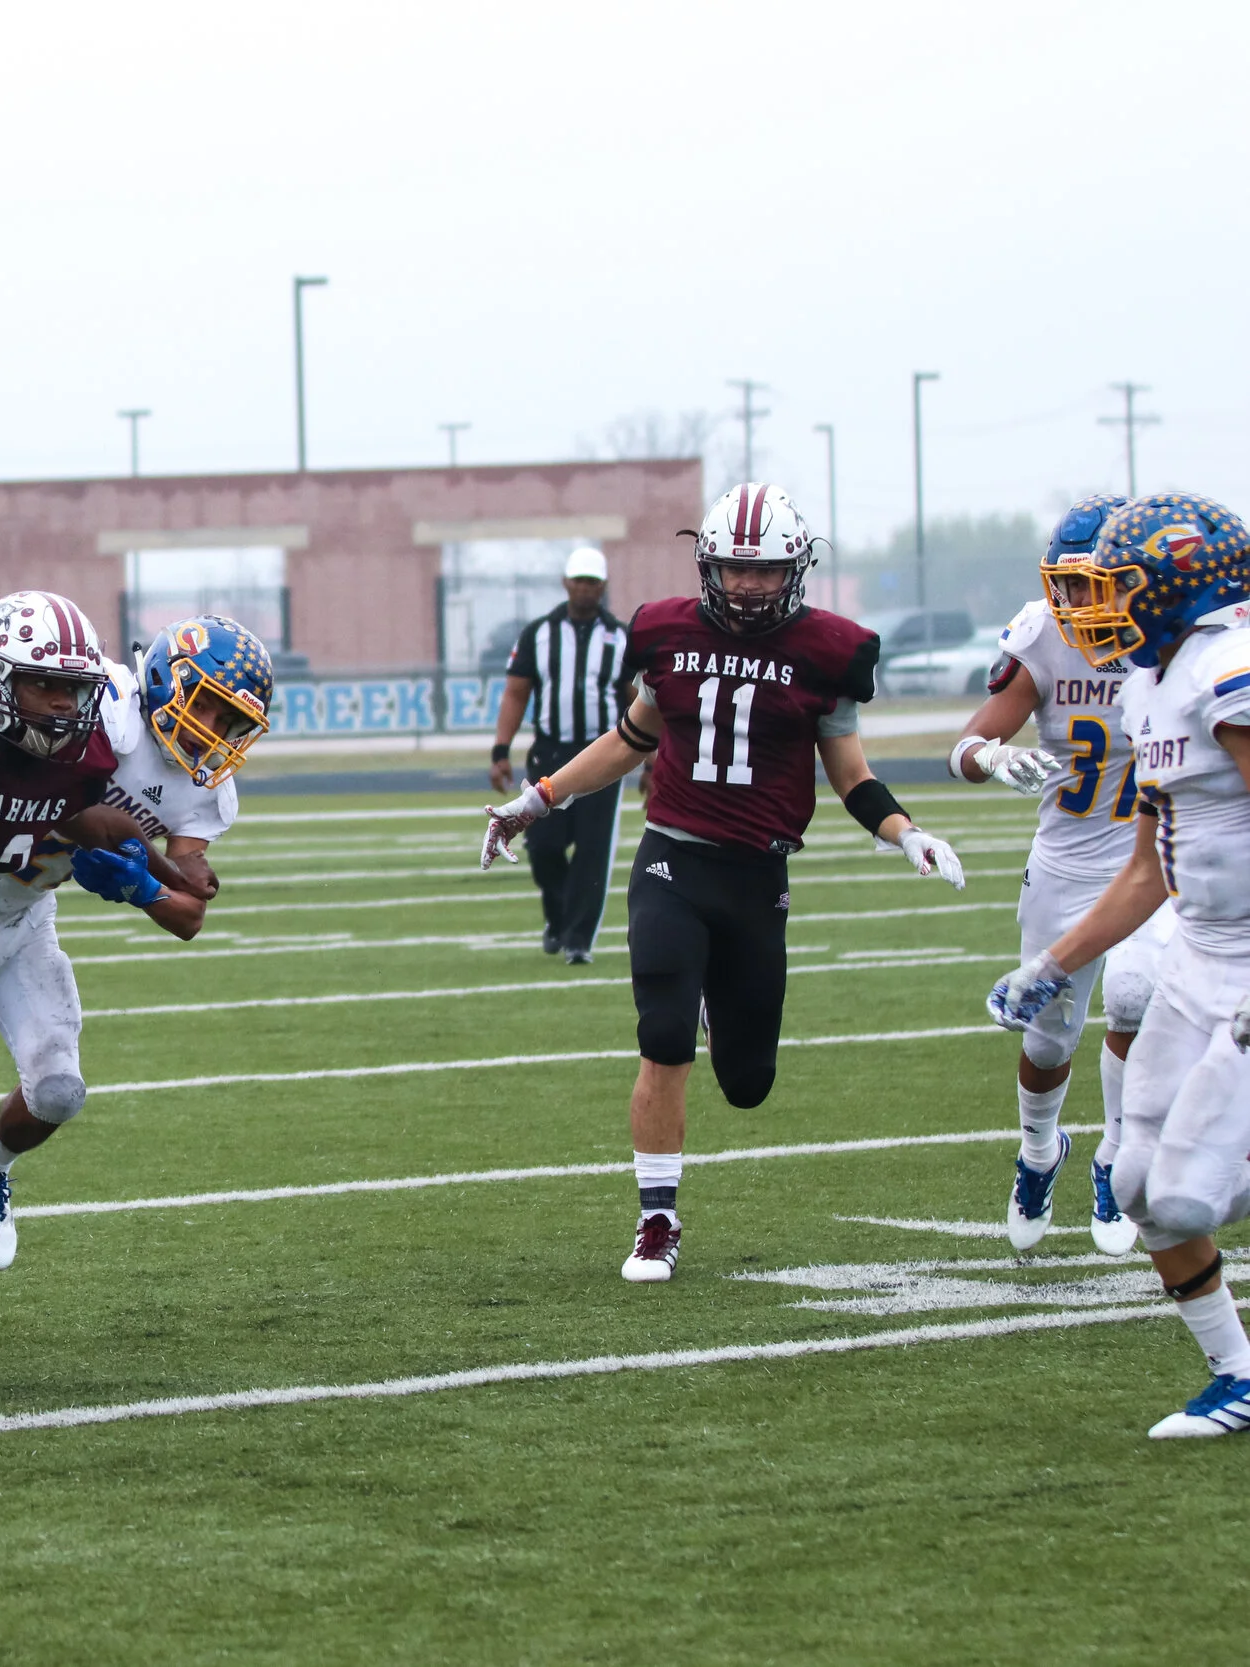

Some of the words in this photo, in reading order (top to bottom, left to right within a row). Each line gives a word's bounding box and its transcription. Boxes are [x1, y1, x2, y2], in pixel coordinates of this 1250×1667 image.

[672, 651, 794, 686] BRAHMAS
[1096, 665, 1128, 674] adidas
[692, 676, 756, 785] 11
[100, 776, 171, 841] OMFOR
[141, 787, 162, 806] adidas
[645, 865, 673, 882] adidas
